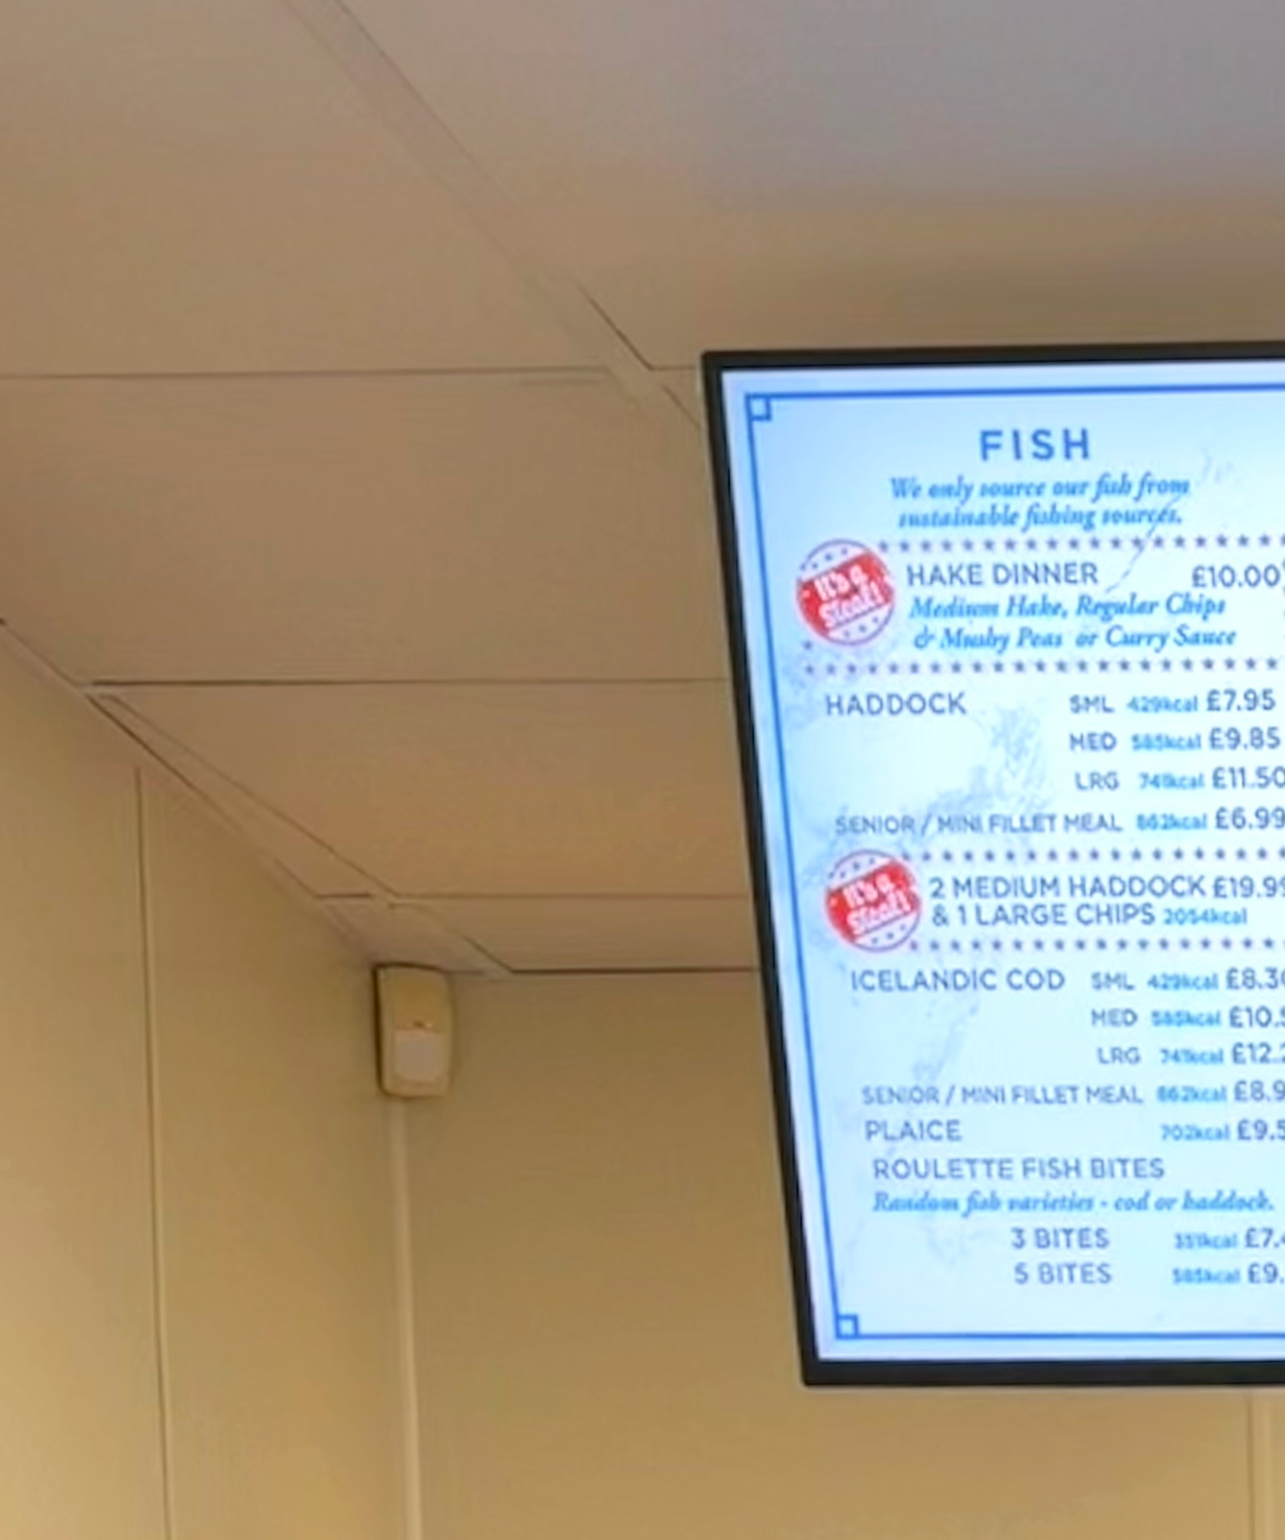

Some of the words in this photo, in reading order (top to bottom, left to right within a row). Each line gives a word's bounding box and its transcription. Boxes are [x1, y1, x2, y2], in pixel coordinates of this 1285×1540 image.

[980, 428, 1089, 461] FISH
[890, 477, 922, 499] We
[928, 475, 974, 506] only
[979, 476, 1046, 498] source
[1052, 475, 1090, 496] our
[1091, 472, 1132, 503] fish
[907, 563, 983, 587] HAKE
[993, 562, 1098, 585] DINNER
[1192, 564, 1281, 588] £10.00
[824, 692, 966, 716] HADDOCK
[1069, 695, 1114, 714] SML
[1207, 689, 1276, 712] £7.95
[929, 877, 945, 899] 2
[952, 876, 1060, 899] MEDIUM
[1069, 875, 1206, 898] HADDOCK
[932, 904, 949, 927] &
[975, 903, 1067, 926] LARGE
[1075, 902, 1155, 926] CHIPS
[851, 968, 996, 992] ICELANDIC
[1006, 968, 1065, 991] COD
[1091, 972, 1135, 991] SML
[865, 1119, 962, 1142] PLAICE
